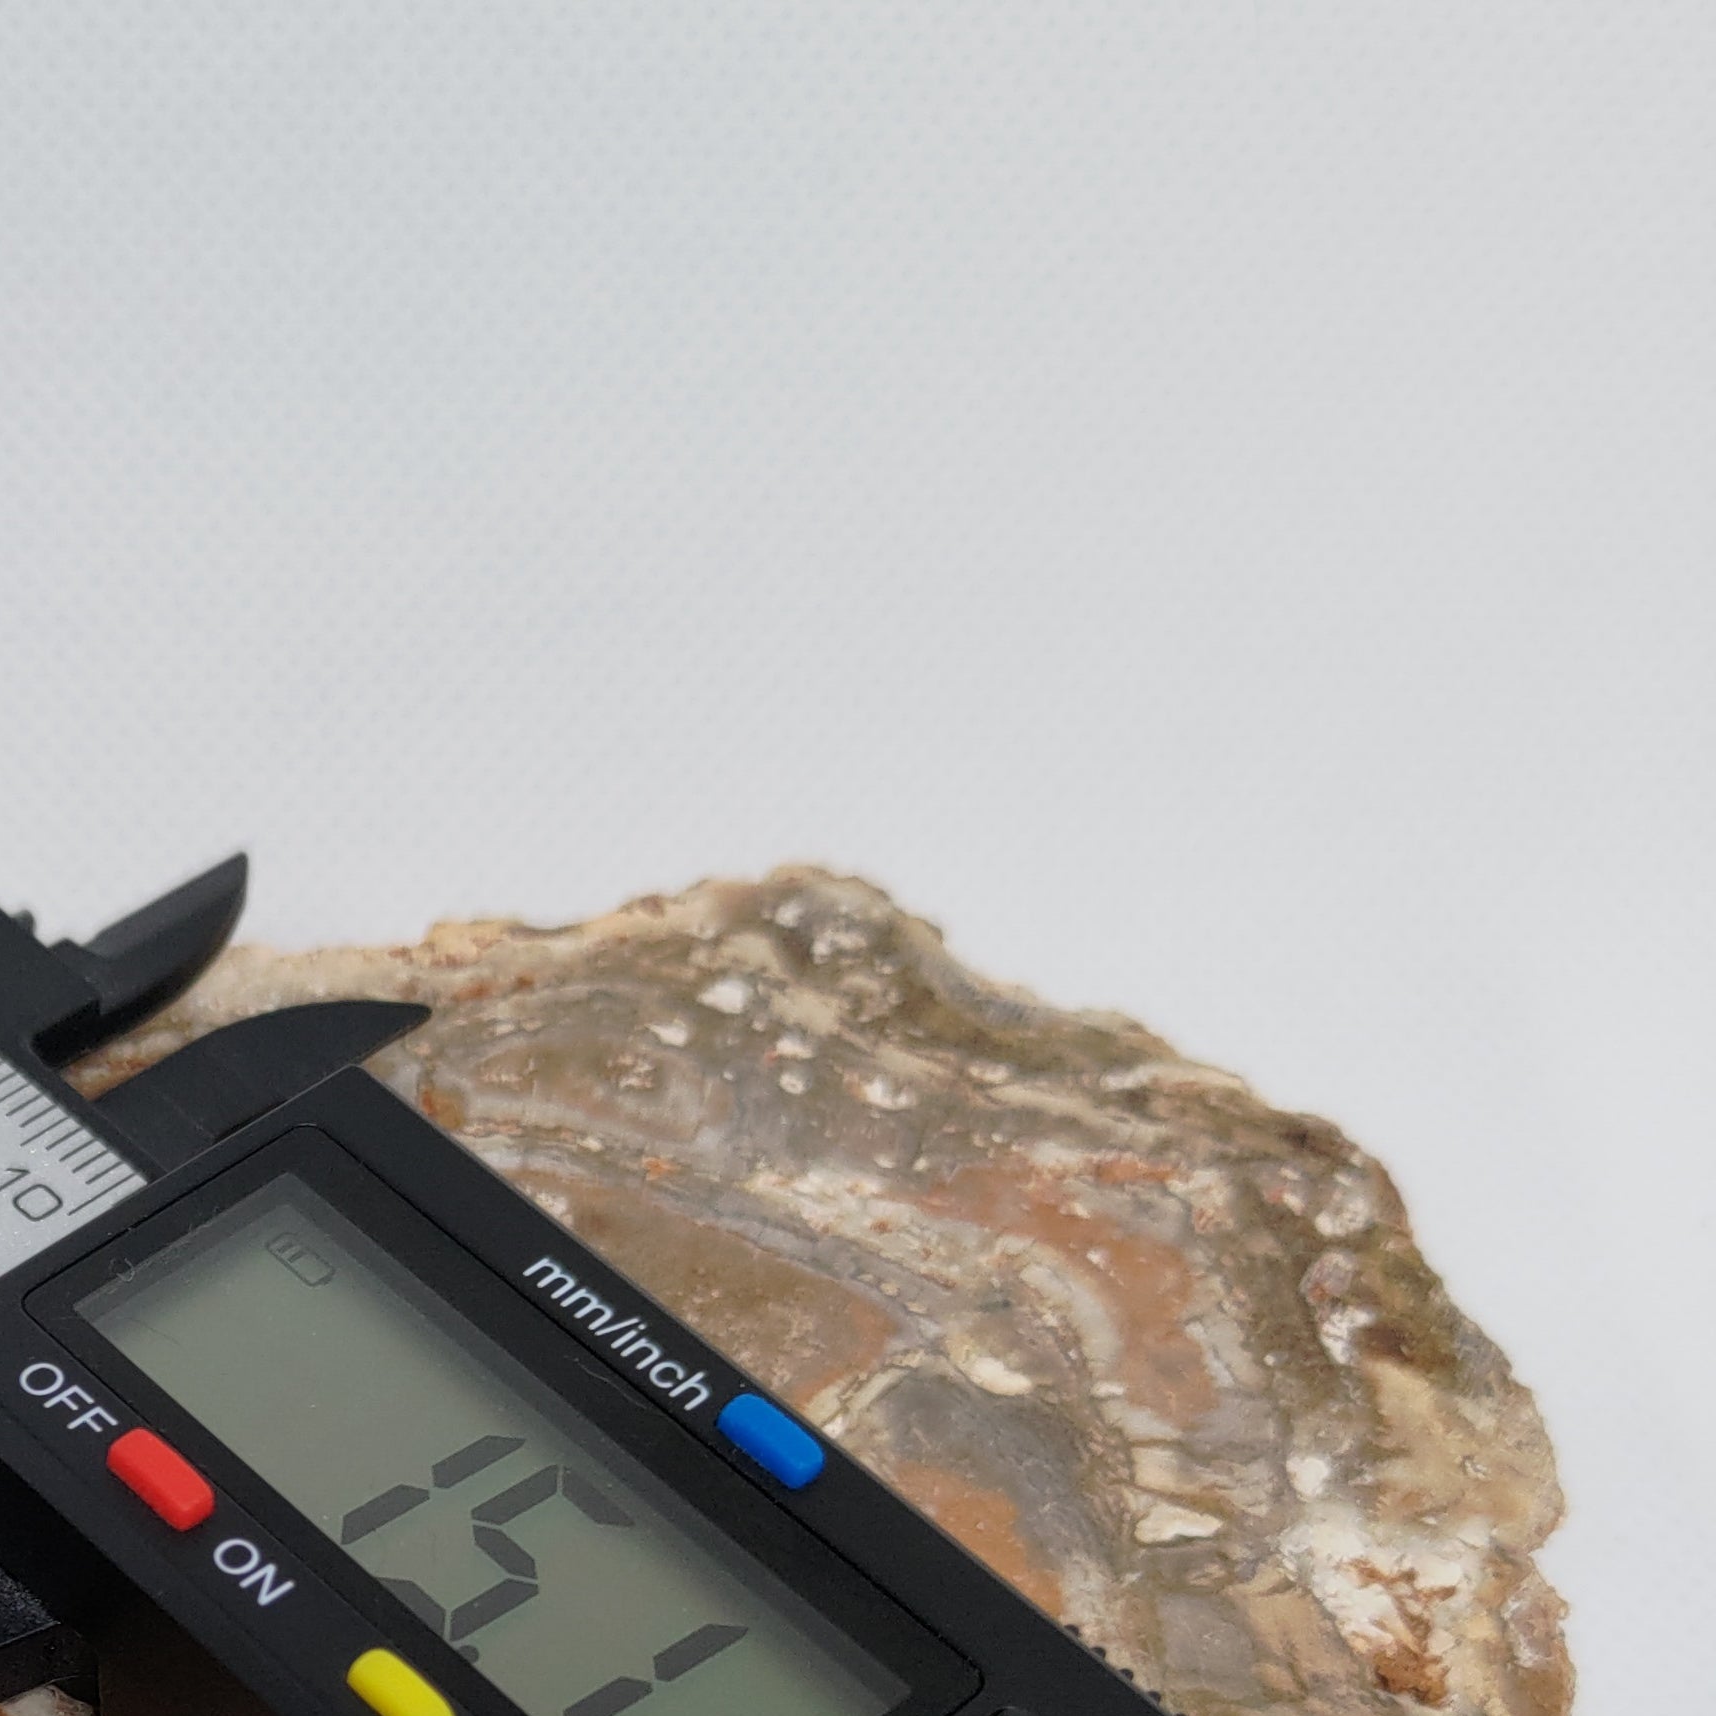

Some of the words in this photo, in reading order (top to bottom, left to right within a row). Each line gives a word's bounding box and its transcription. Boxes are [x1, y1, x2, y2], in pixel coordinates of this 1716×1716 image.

[522, 1254, 715, 1414] mm/inch
[17, 1360, 118, 1440] OFF
[211, 1536, 296, 1608] ON
